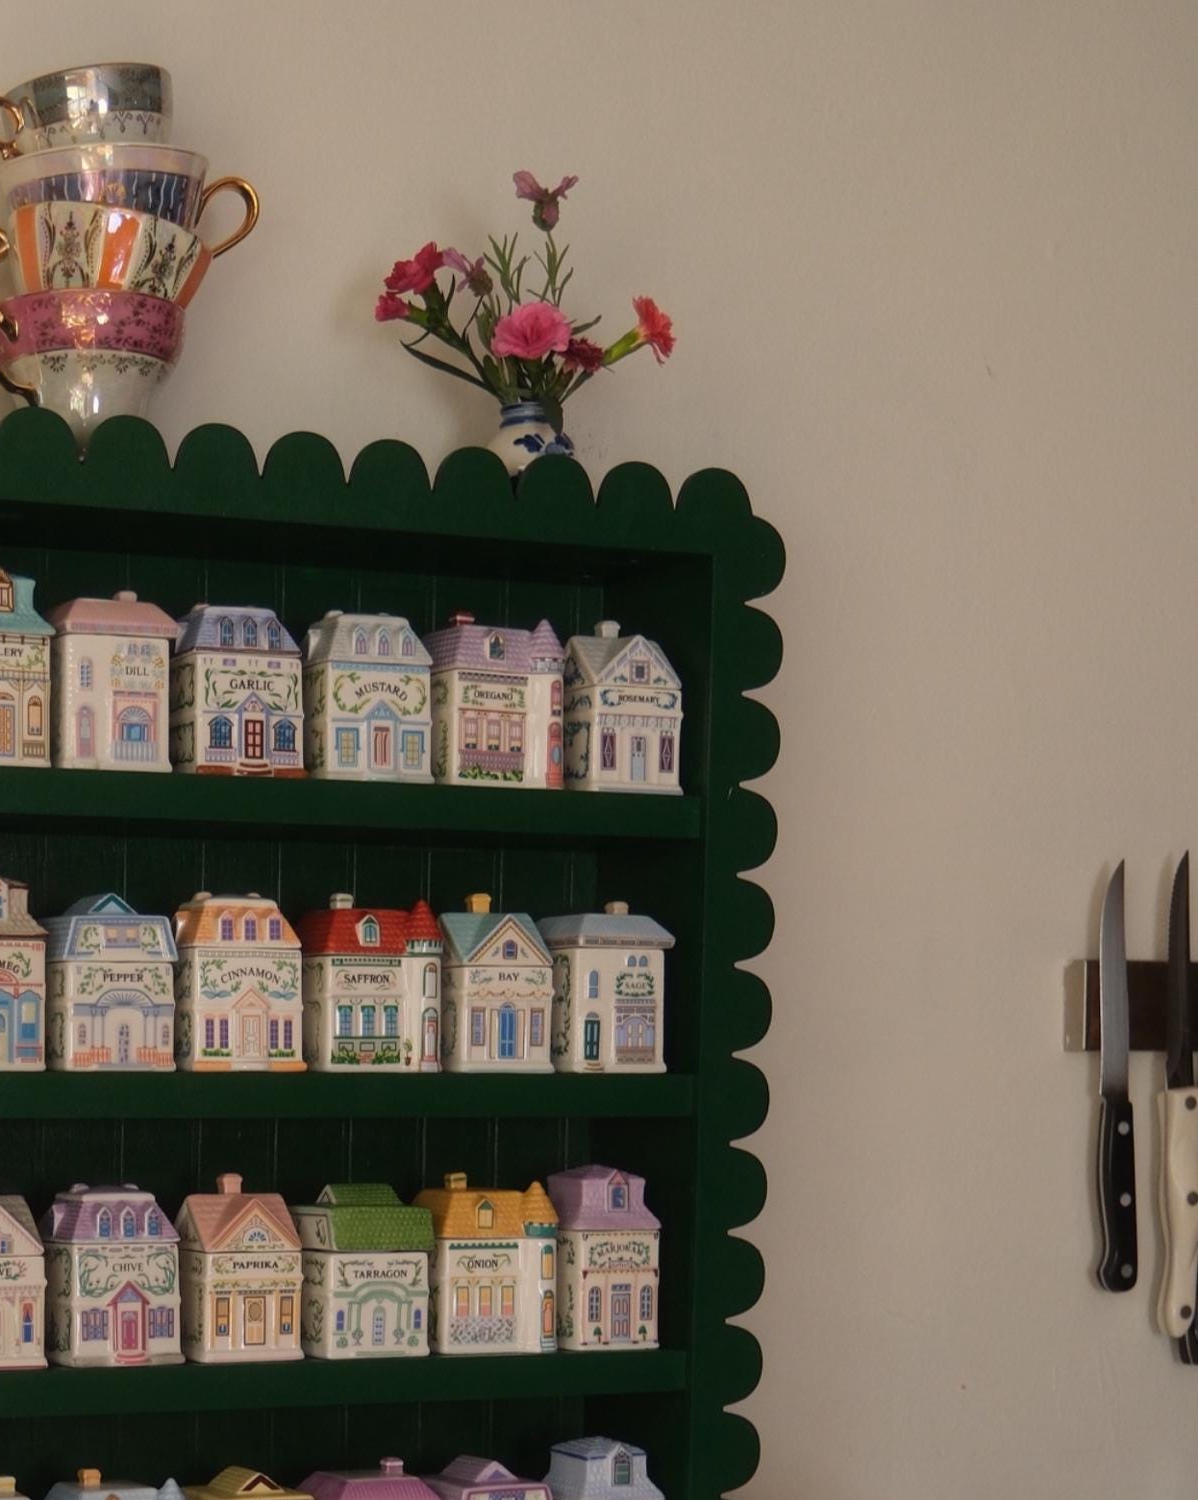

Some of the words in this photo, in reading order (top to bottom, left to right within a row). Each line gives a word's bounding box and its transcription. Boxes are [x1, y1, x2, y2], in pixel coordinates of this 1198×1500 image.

[125, 667, 149, 676] DILL
[230, 678, 275, 691] GARLIC
[355, 682, 408, 701] MUSTARD
[473, 689, 513, 701] OREGANO
[618, 694, 660, 704] ROSEMARY
[103, 973, 144, 982] PEPPER
[221, 967, 281, 985] CINNAMON
[343, 974, 390, 984] SAFFRON
[499, 973, 519, 982] BAY
[597, 1244, 644, 1258] MARJORAM
[112, 1263, 144, 1272] CHIVE
[232, 1261, 278, 1270] PAPRIKA
[467, 1259, 499, 1269] ONION
[354, 1269, 408, 1278] TARRAGON
